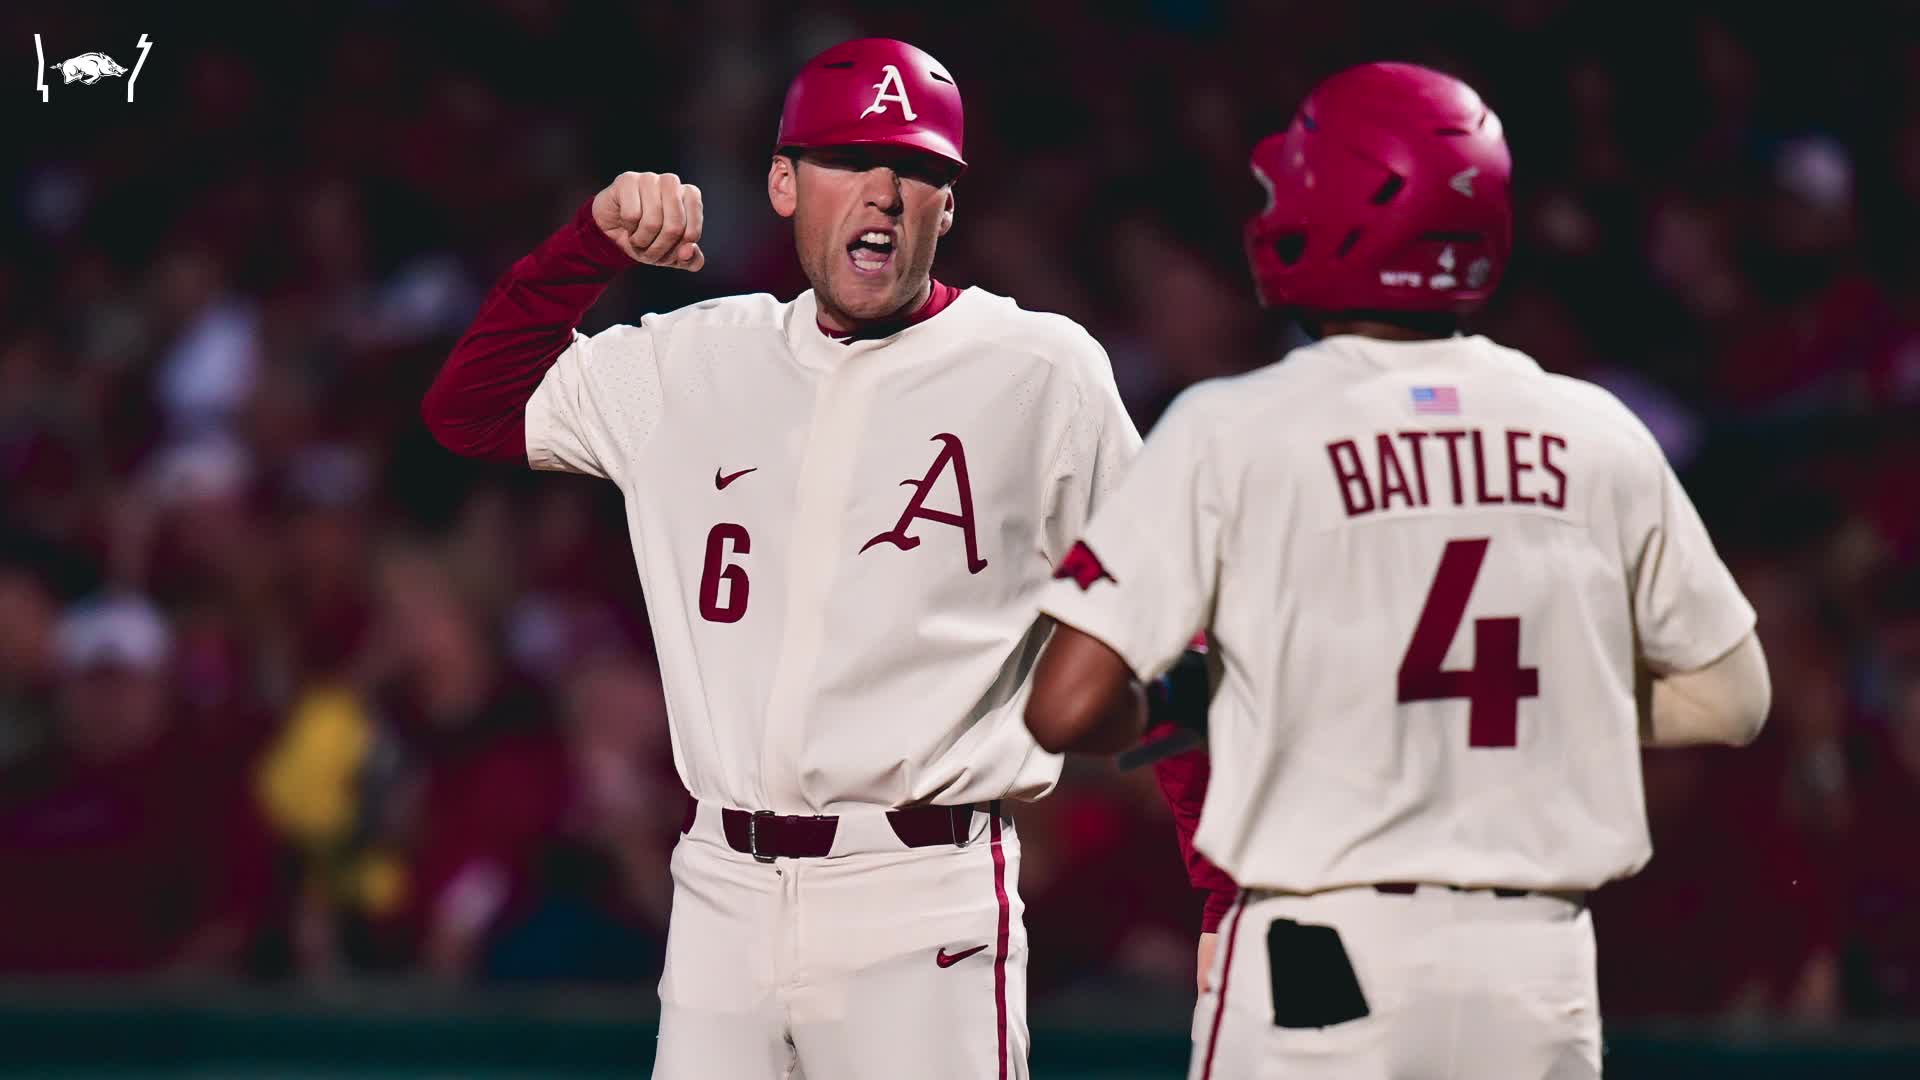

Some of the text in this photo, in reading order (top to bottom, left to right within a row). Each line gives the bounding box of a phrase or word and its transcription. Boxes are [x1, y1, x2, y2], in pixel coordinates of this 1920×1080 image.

[860, 64, 918, 121] A
[859, 432, 988, 575] A
[1327, 430, 1567, 517] BATTLES
[698, 522, 751, 624] 6
[1396, 537, 1539, 749] 4
